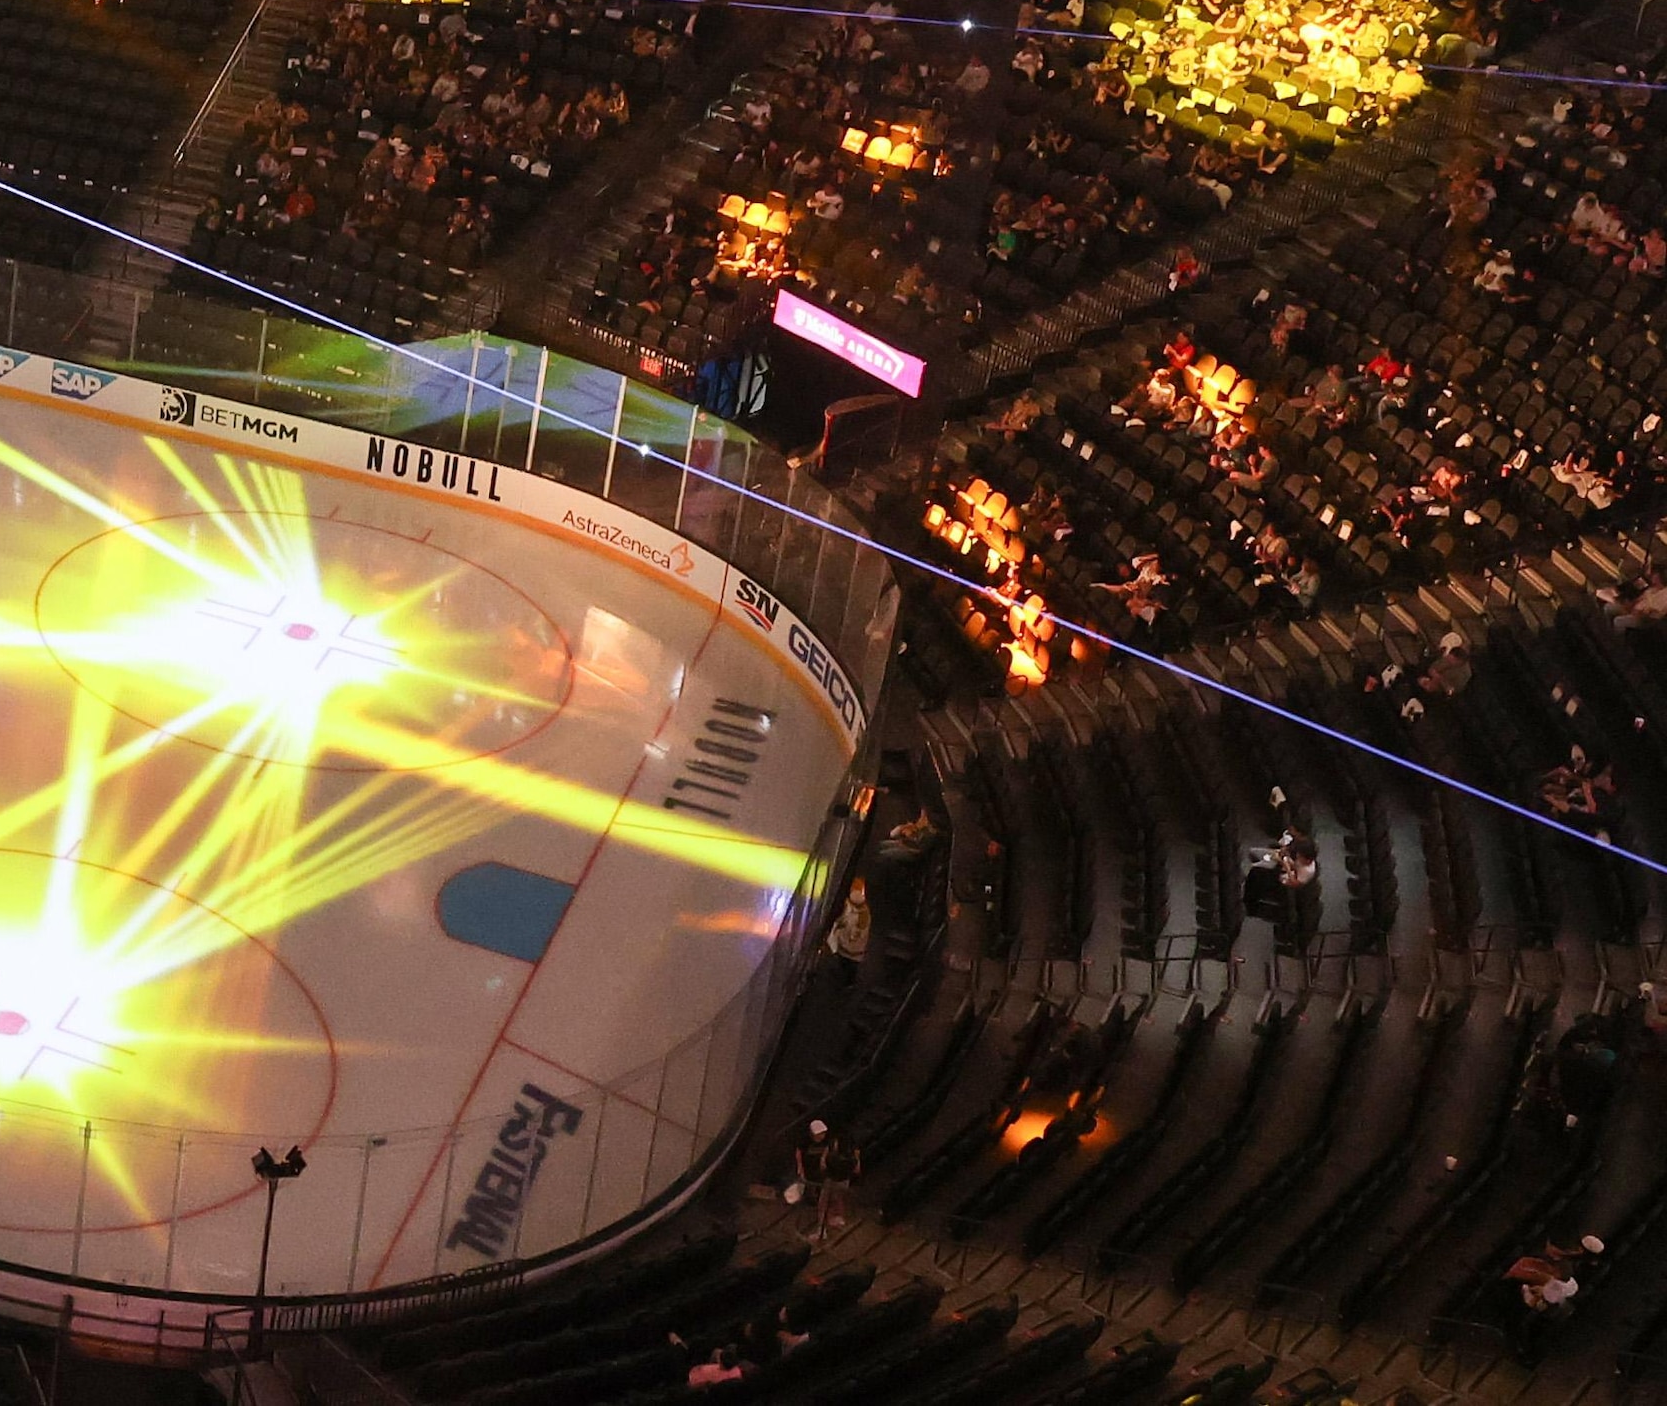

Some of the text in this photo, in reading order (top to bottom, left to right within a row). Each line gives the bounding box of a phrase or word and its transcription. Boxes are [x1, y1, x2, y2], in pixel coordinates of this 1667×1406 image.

[805, 314, 845, 348] Mobile
[846, 340, 893, 373] ARENA
[52, 368, 103, 396] SAP
[200, 405, 298, 443] BETMGM
[367, 436, 502, 502] NOBULL
[562, 509, 671, 570] AstraZeneca
[735, 578, 780, 622] SN
[788, 624, 858, 732] GEICO
[444, 1082, 584, 1258] FASTENAL
